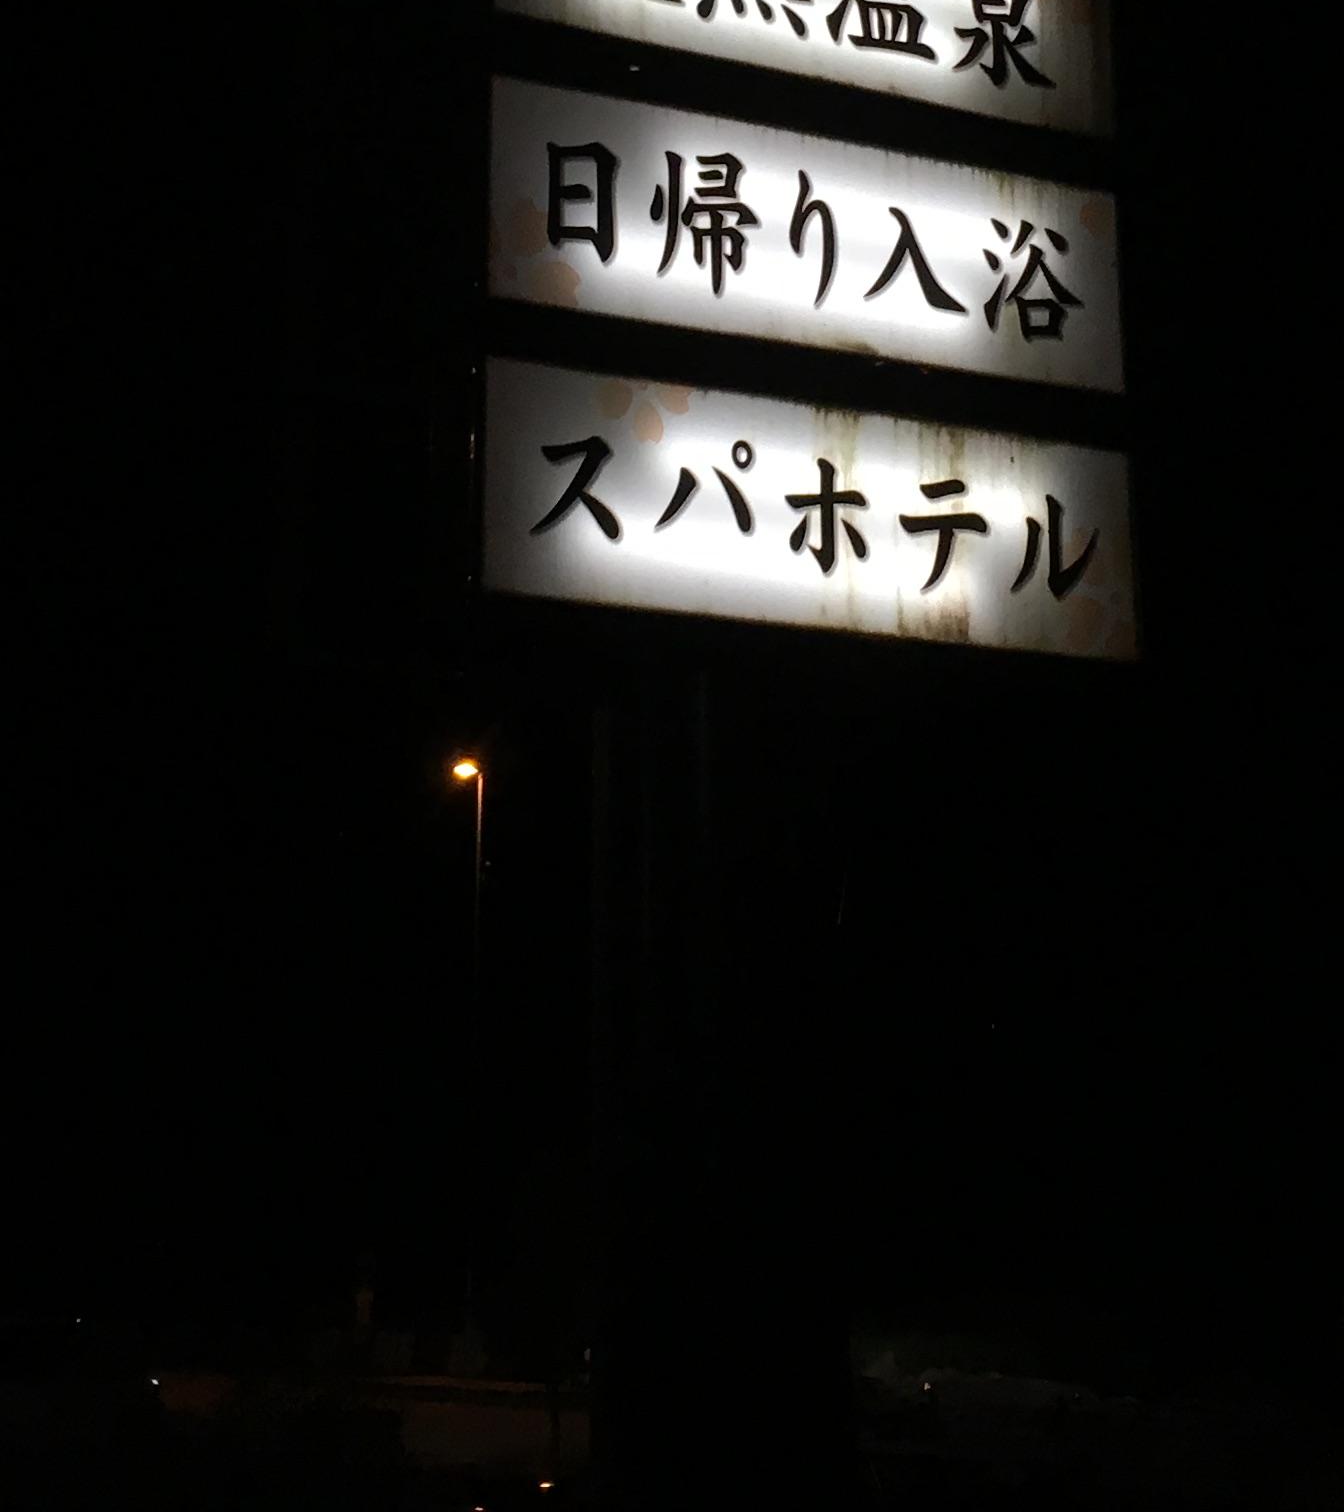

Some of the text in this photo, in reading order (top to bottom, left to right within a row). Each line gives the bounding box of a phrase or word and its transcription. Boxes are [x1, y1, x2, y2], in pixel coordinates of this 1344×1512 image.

[546, 141, 1084, 341] 日帰り入浴
[530, 435, 1100, 600] スパホテル
